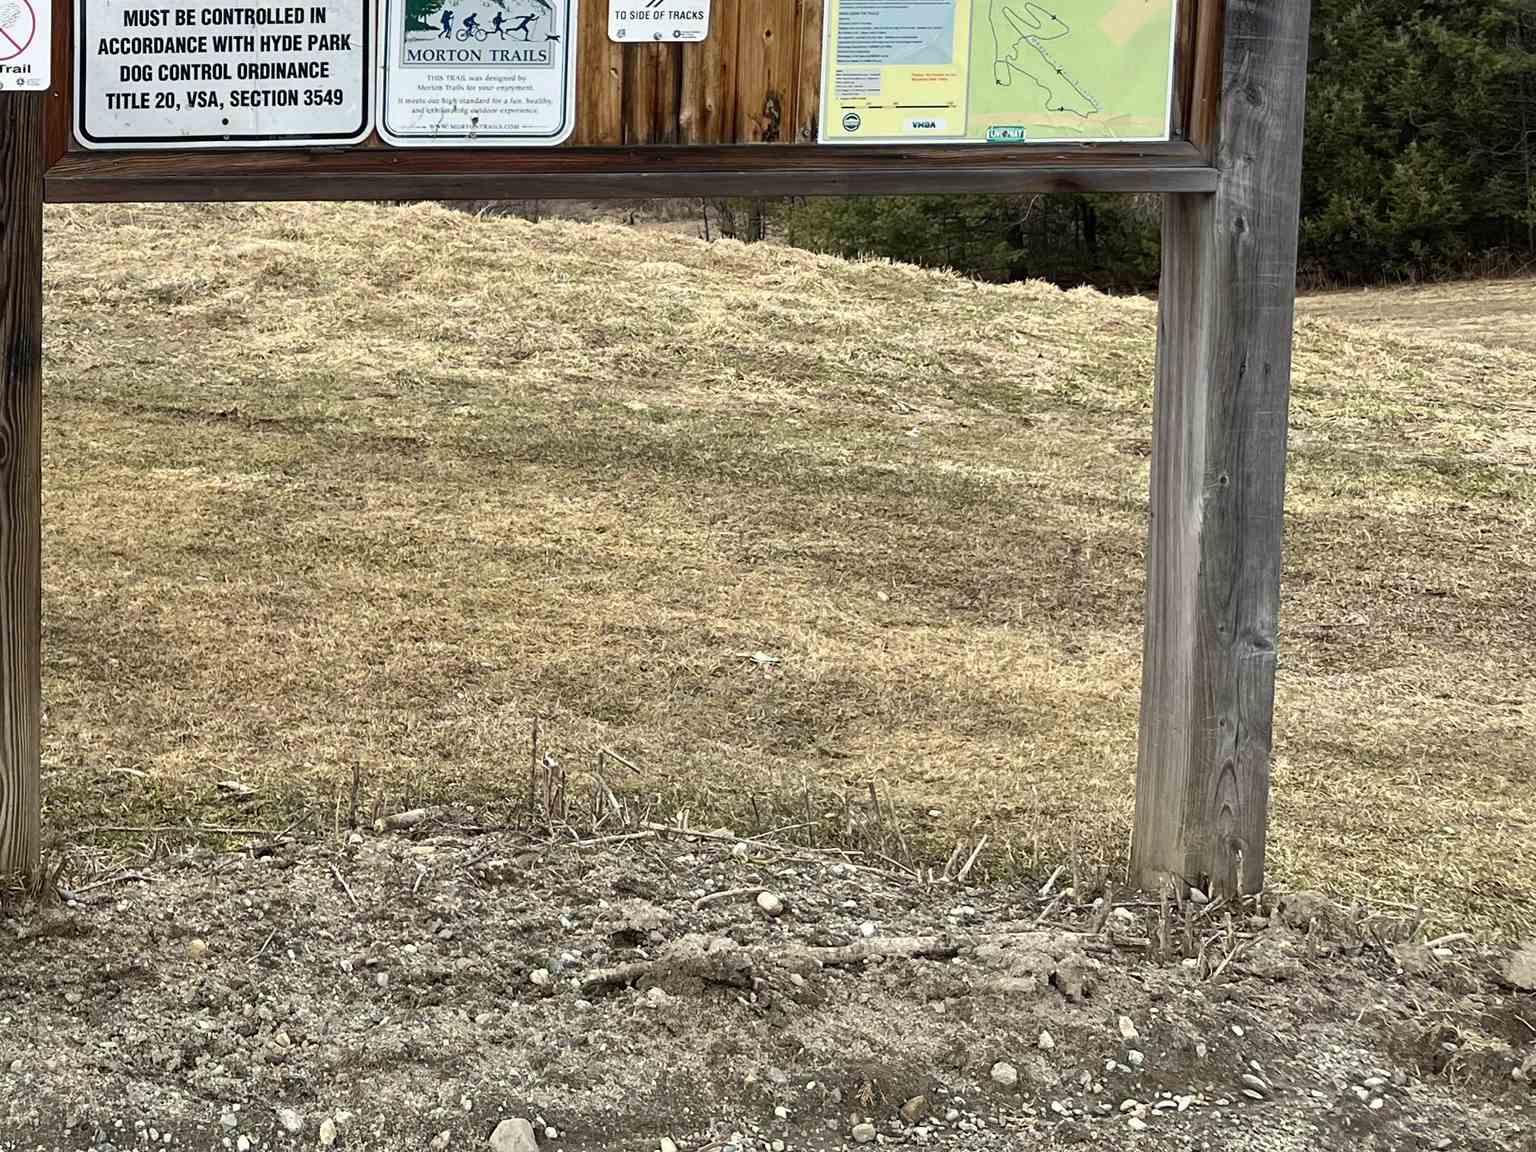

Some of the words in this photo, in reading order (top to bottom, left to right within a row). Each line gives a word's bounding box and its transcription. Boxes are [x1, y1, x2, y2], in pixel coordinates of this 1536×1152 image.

[124, 9, 170, 27] MUST
[175, 8, 196, 27] BE
[201, 7, 305, 26] CONTROLLED
[310, 7, 326, 24] IN
[616, 10, 626, 20] TO
[630, 10, 649, 20] SIDE
[653, 10, 664, 20] OF
[669, 10, 704, 20] TRACKS
[98, 36, 207, 56] ACCORDANCE
[212, 36, 255, 54] WITH
[261, 34, 302, 53] HYDE
[307, 34, 351, 51] PARK
[407, 49, 482, 62] MORTON
[490, 49, 547, 62] TRAILS
[120, 64, 153, 82] DOG
[159, 63, 232, 81] CONTROL
[237, 62, 329, 80] ORDINANCE
[106, 93, 150, 110] TITLE
[156, 93, 181, 112] 20,
[188, 91, 224, 110] VSA,
[230, 90, 298, 108] SECTION
[304, 89, 343, 107] 3549
